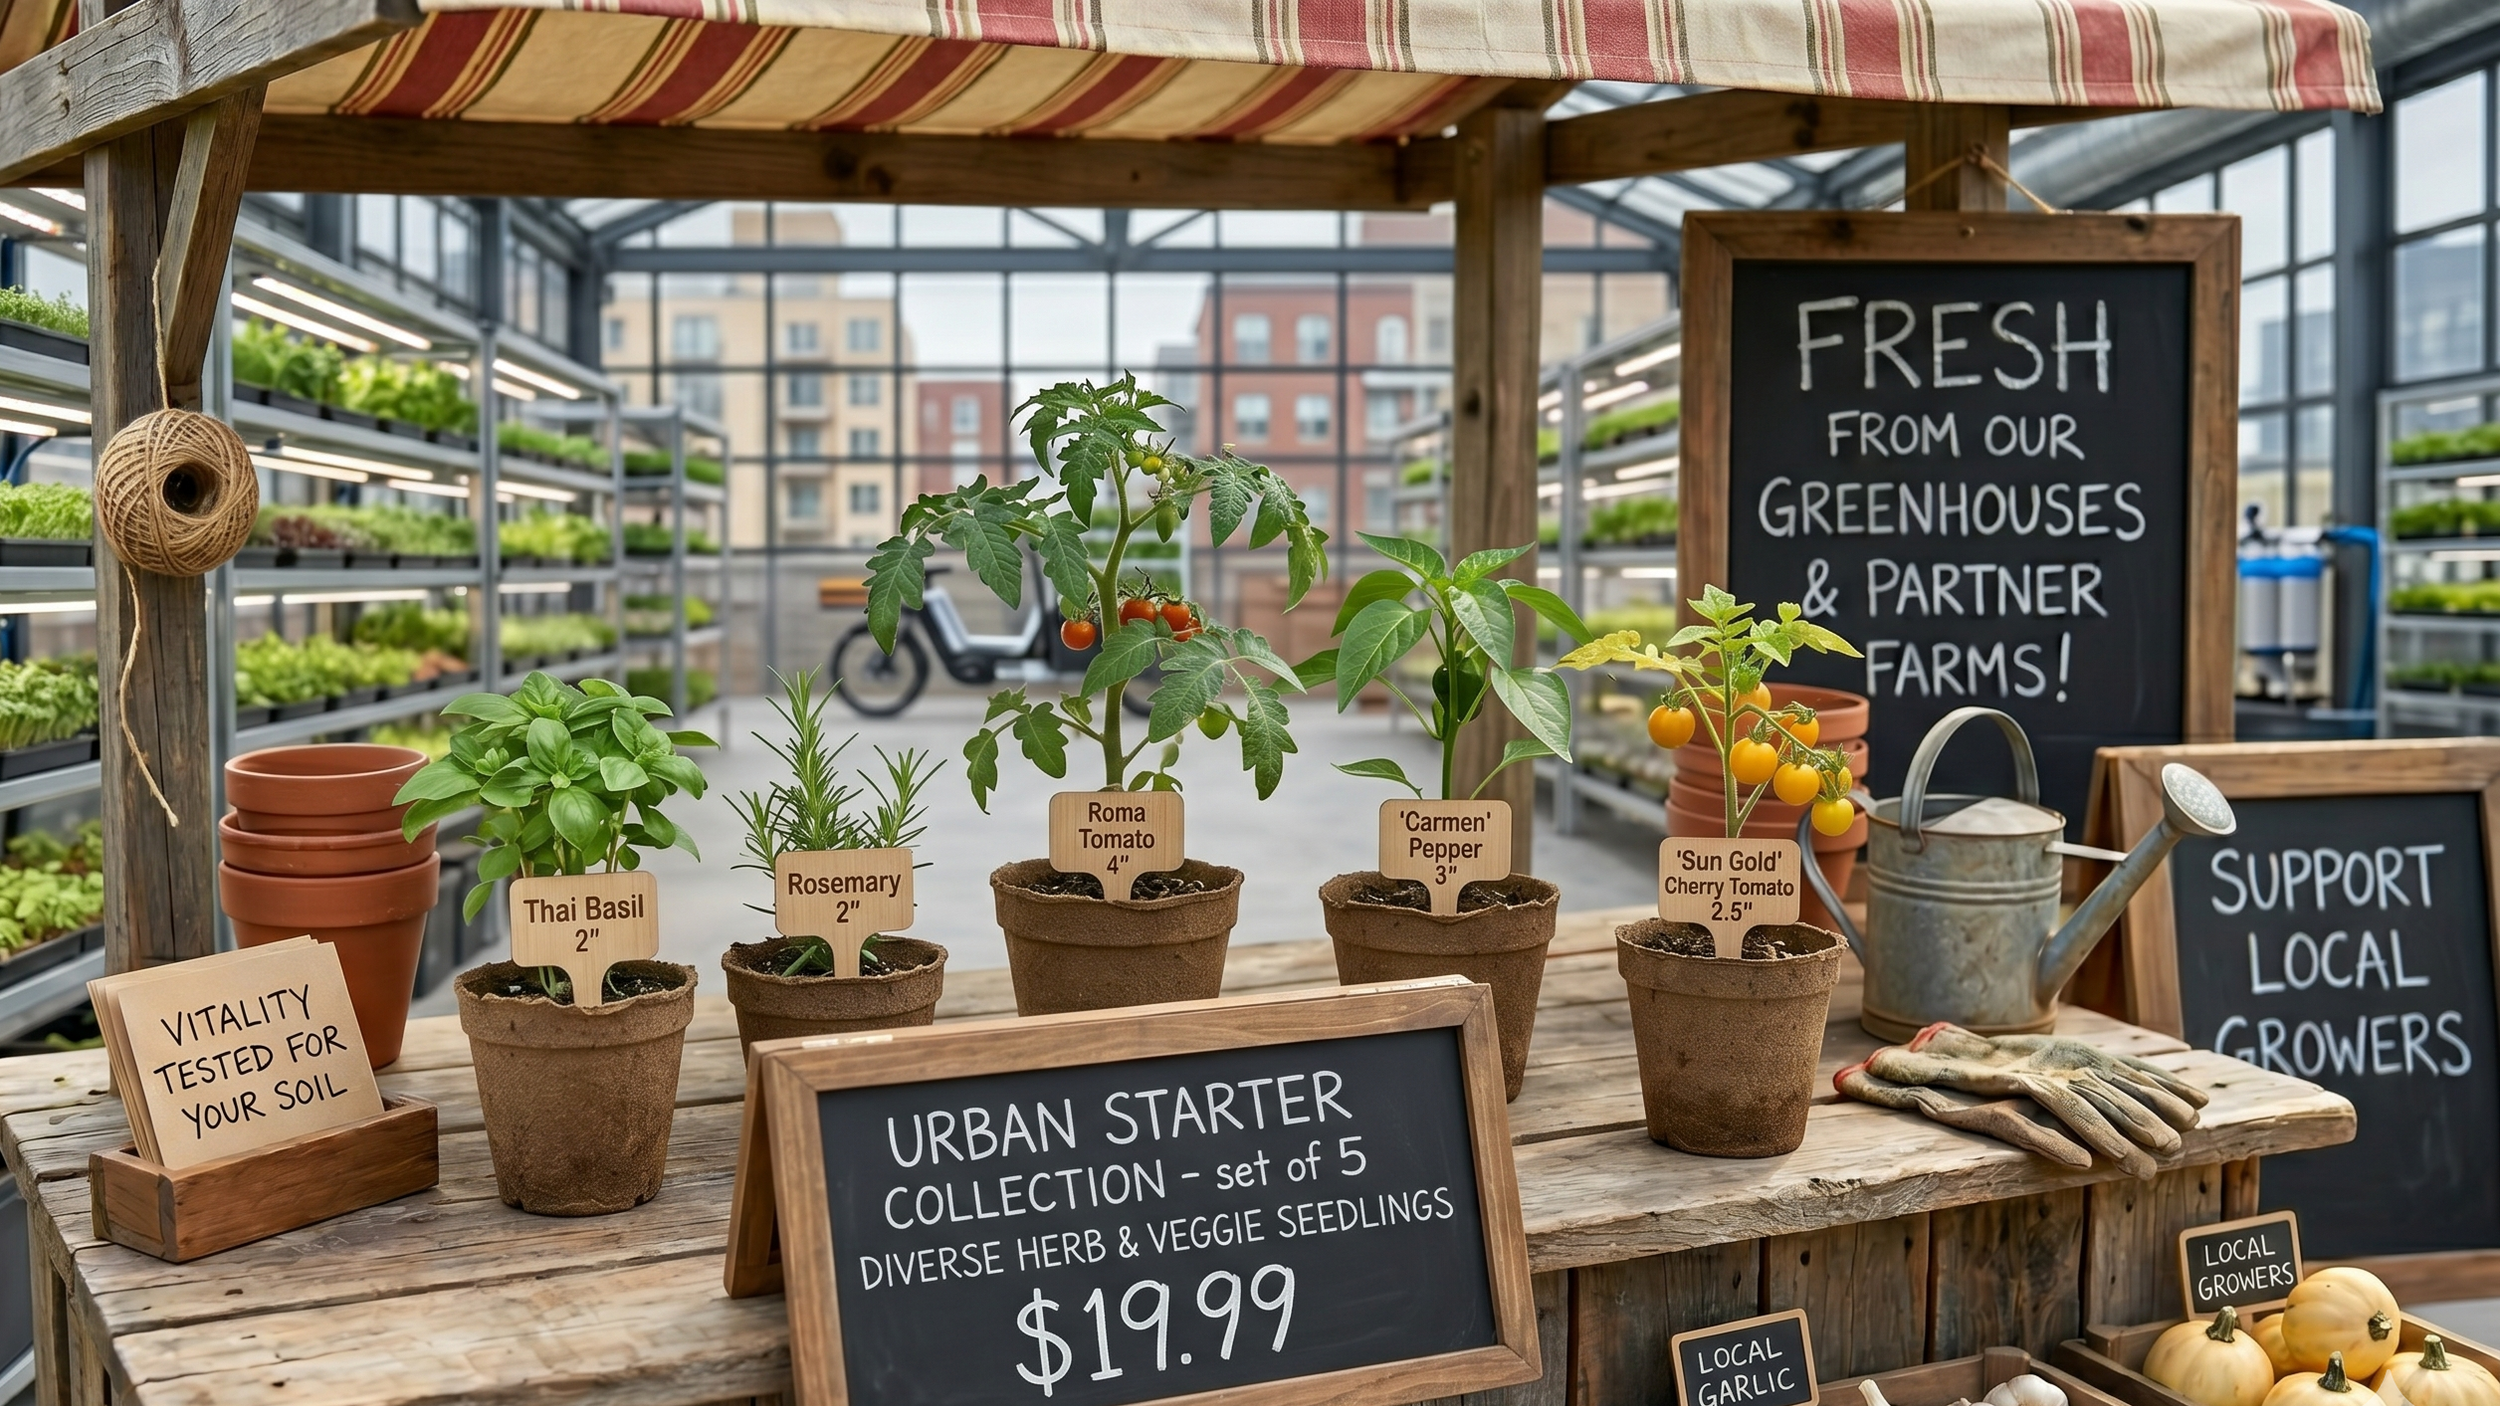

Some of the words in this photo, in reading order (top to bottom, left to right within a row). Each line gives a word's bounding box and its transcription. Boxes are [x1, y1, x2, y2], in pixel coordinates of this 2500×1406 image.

[1798, 296, 2112, 393] FRESH
[1827, 410, 1961, 458] FROM
[1984, 413, 2085, 460] OUR
[1758, 476, 2146, 542] GREENHOUSES
[1801, 558, 1839, 618] &
[1866, 558, 2108, 617] PARTNER
[1866, 631, 2071, 703] FARMS!
[1088, 801, 1146, 823] Roma
[1399, 810, 1491, 833] 'Carmen'
[1078, 828, 1155, 849] Tomato
[1409, 837, 1484, 864] Pepper
[1106, 854, 1129, 875] 4"
[1435, 864, 1458, 886] 3"
[1676, 849, 1722, 872] 'Sun
[1729, 850, 1782, 872] Gold'
[2211, 844, 2445, 915] SUPPORT
[788, 872, 902, 898] Rosemary
[1664, 876, 1725, 901] Cherry
[1728, 877, 1795, 897] Tomato
[522, 896, 577, 924] Thai
[585, 893, 644, 921] Basil
[836, 899, 860, 924] 2"
[1711, 901, 1753, 922] 2.5"
[575, 927, 600, 953] 2"
[2248, 929, 2430, 995] LOCAL
[160, 983, 311, 1046] VITALITY
[152, 1044, 274, 1095] TESTED
[285, 1025, 348, 1063] FOR
[2214, 1010, 2472, 1077] GROWERS
[181, 1091, 267, 1140] YOUR
[274, 1072, 348, 1111] SOIL
[887, 1098, 1076, 1168] URBAN
[1104, 1070, 1353, 1145] STARTER
[884, 1159, 1166, 1230] COLLECTION
[1216, 1149, 1271, 1190] set
[1287, 1139, 1322, 1182] of
[1338, 1135, 1367, 1176] 5
[859, 1240, 1005, 1291] DIVERSE
[1016, 1228, 1107, 1272] HERB
[1118, 1225, 1140, 1259] &
[1146, 1208, 1265, 1254] VEGGIE
[1277, 1186, 1454, 1238] SEEDLINGS
[2204, 1234, 2276, 1267] LOCAL
[2198, 1261, 2294, 1302] GROWERS
[1014, 1263, 1295, 1397] $19.99
[1698, 1337, 1783, 1375] LOCAL
[1698, 1367, 1795, 1406] GARLIC
